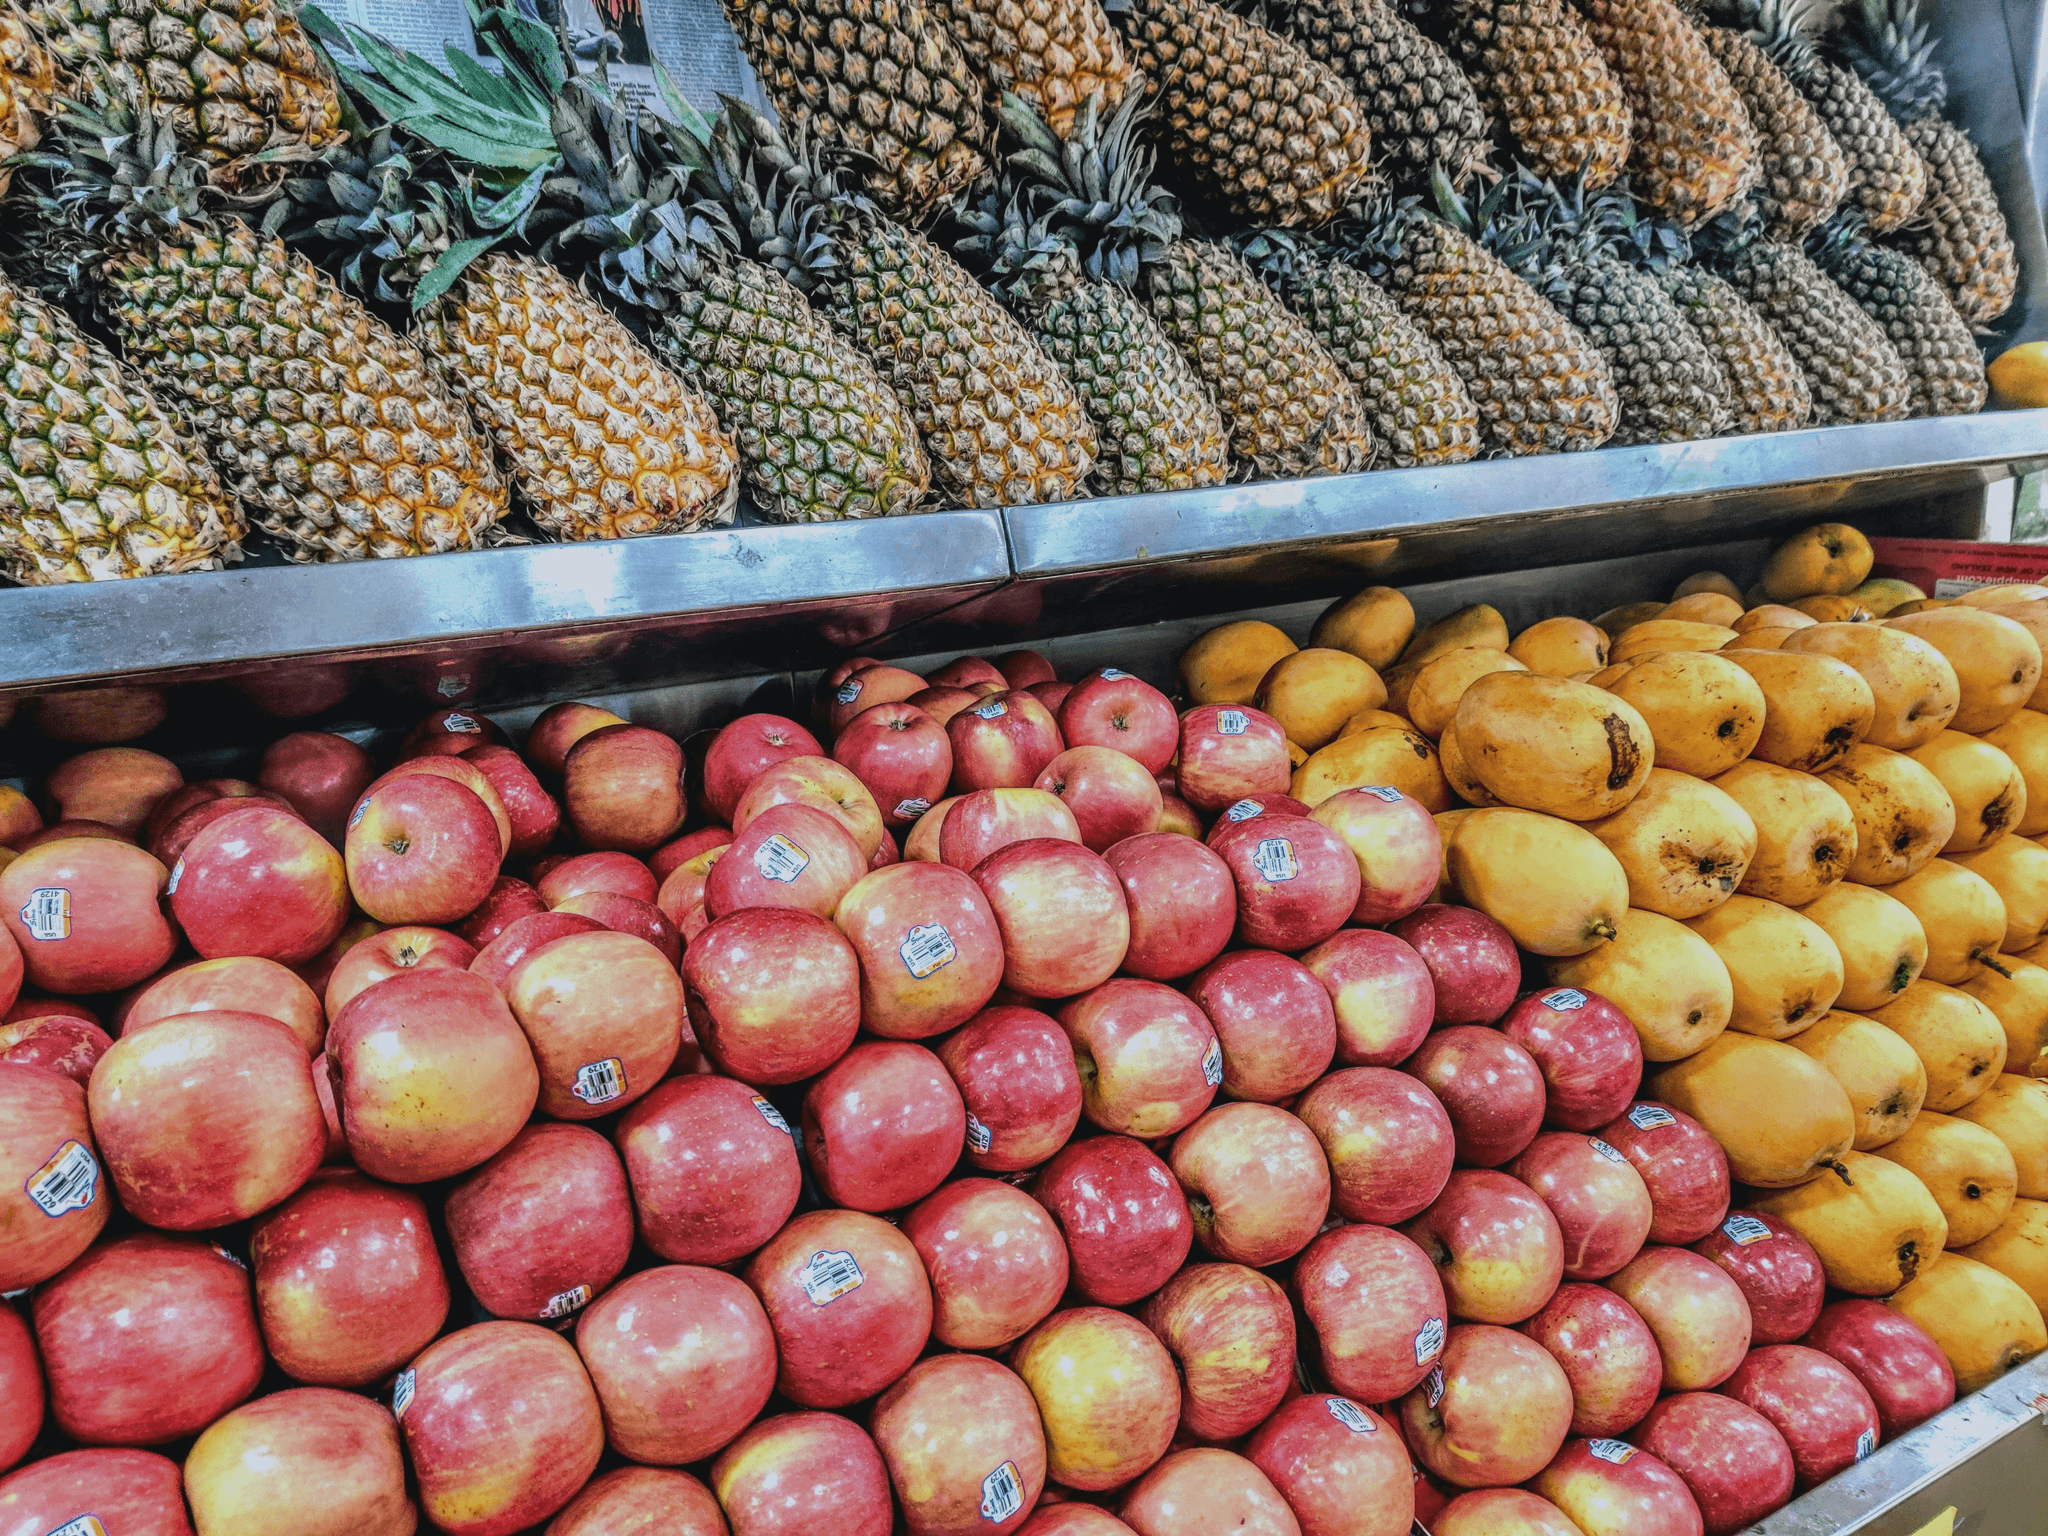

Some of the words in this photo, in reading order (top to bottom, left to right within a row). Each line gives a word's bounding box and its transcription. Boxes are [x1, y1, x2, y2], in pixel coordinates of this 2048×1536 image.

[40, 890, 60, 898] 4129
[938, 931, 952, 949] 4129
[906, 954, 916, 968] USA
[588, 1062, 608, 1073] 4129
[980, 1134, 988, 1149] 4129
[79, 1151, 90, 1164] USA
[35, 1189, 56, 1209] 4129
[843, 1257, 858, 1275] 4129
[806, 1281, 816, 1295] USA
[988, 1467, 1003, 1484] 4129
